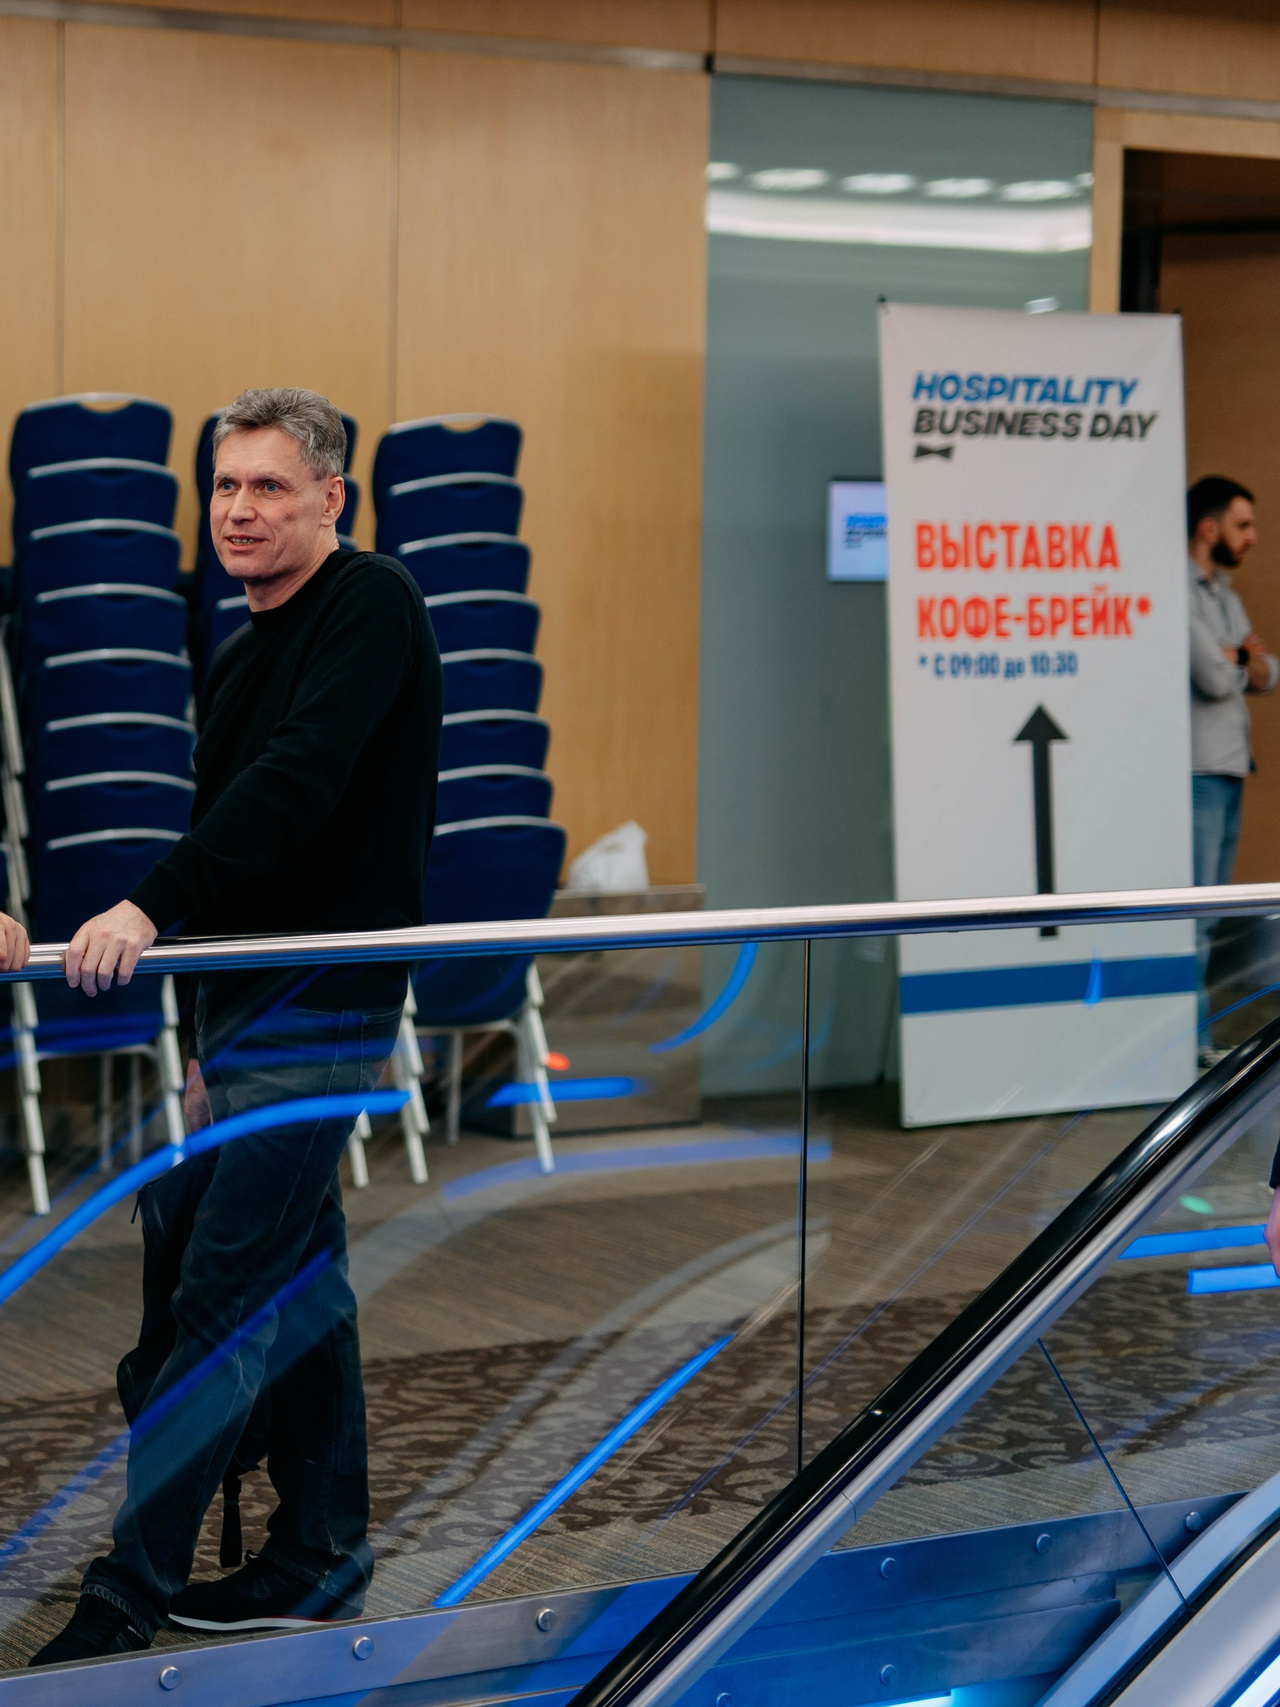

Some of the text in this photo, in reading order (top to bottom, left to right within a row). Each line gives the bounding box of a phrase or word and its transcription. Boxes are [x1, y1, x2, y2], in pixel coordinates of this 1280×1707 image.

[913, 373, 1138, 405] HOSPITALITY
[913, 407, 1159, 441] BUSINESS DAY
[916, 522, 1120, 570] ВЫСТАВКА
[950, 652, 1000, 678] 09:00
